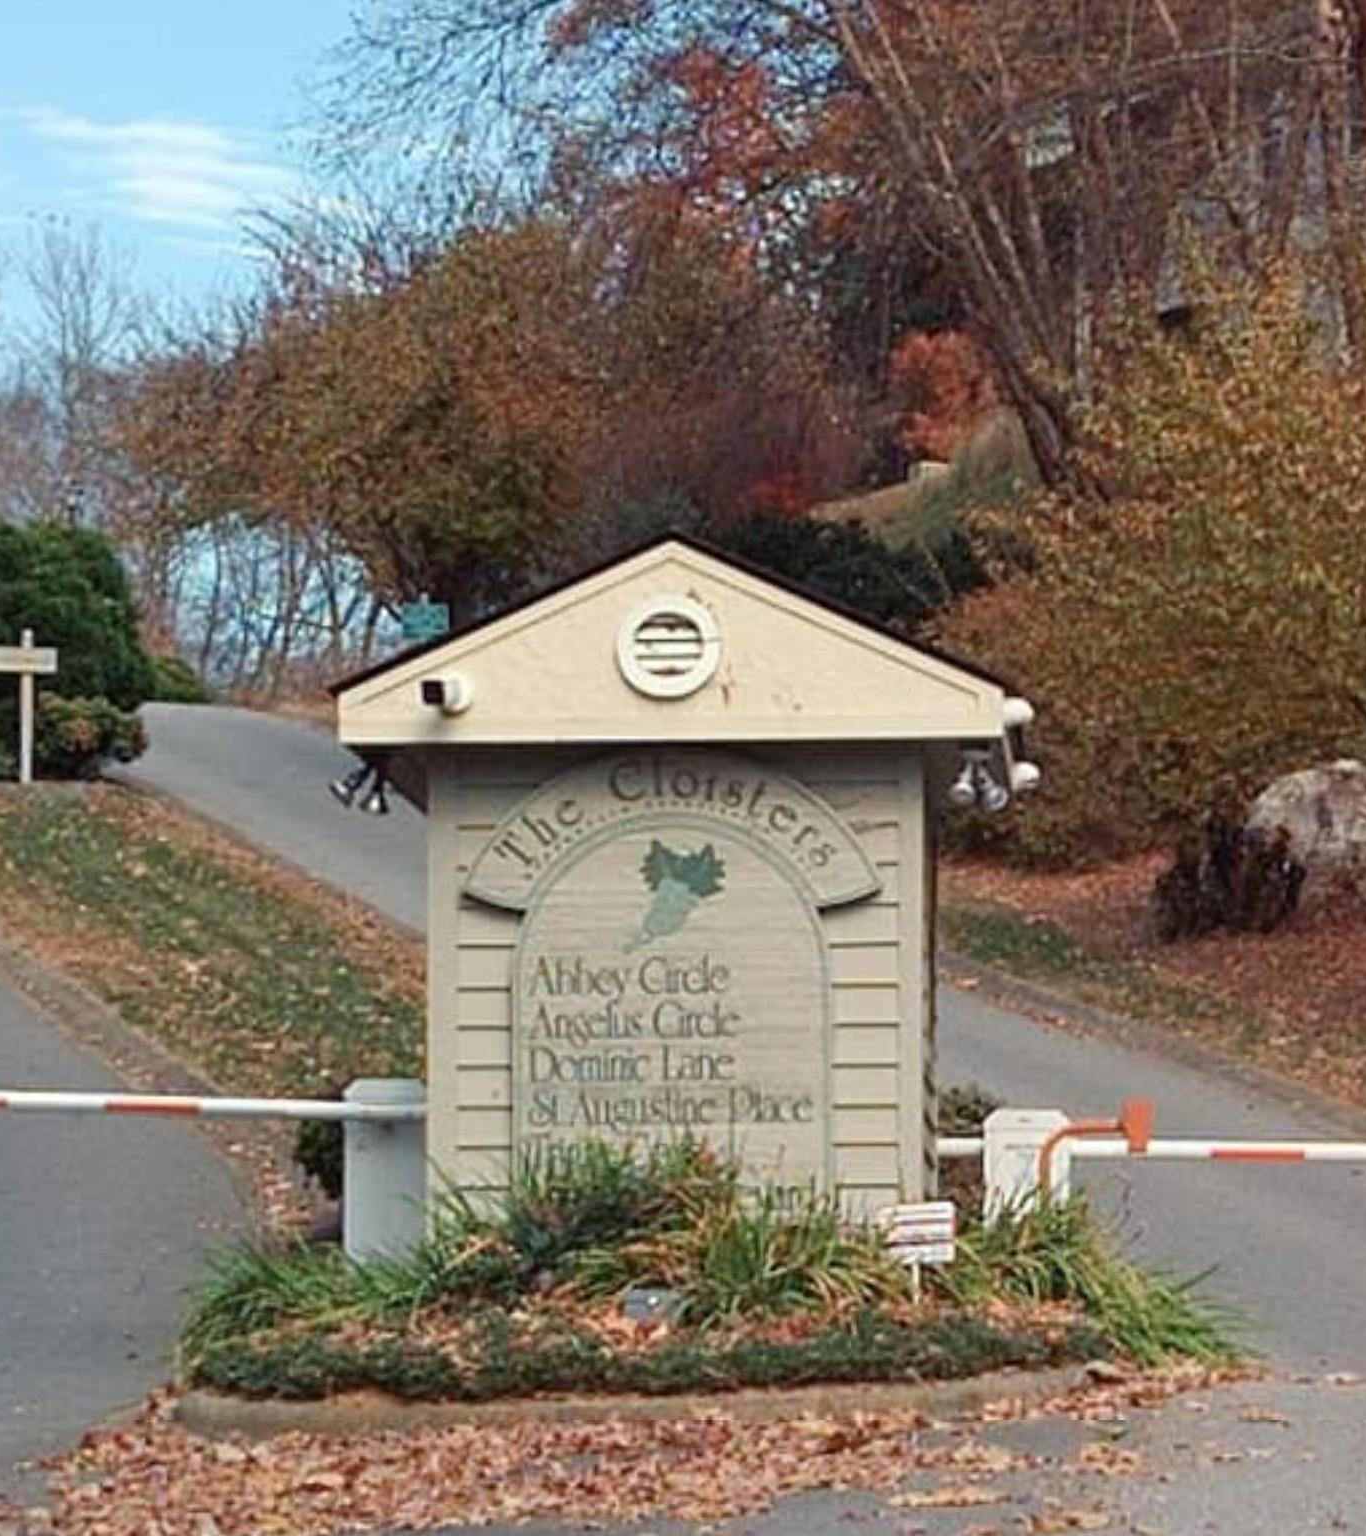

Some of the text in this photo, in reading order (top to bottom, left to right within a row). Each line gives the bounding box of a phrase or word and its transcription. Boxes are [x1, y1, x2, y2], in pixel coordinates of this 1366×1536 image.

[492, 755, 839, 869] The Cloisters
[529, 953, 730, 998] Abbey Circle
[529, 1000, 741, 1048] Angelus Circle
[529, 1044, 737, 1083] Dominic Lane
[569, 1088, 716, 1133] Augustine
[727, 1087, 813, 1124] Place
